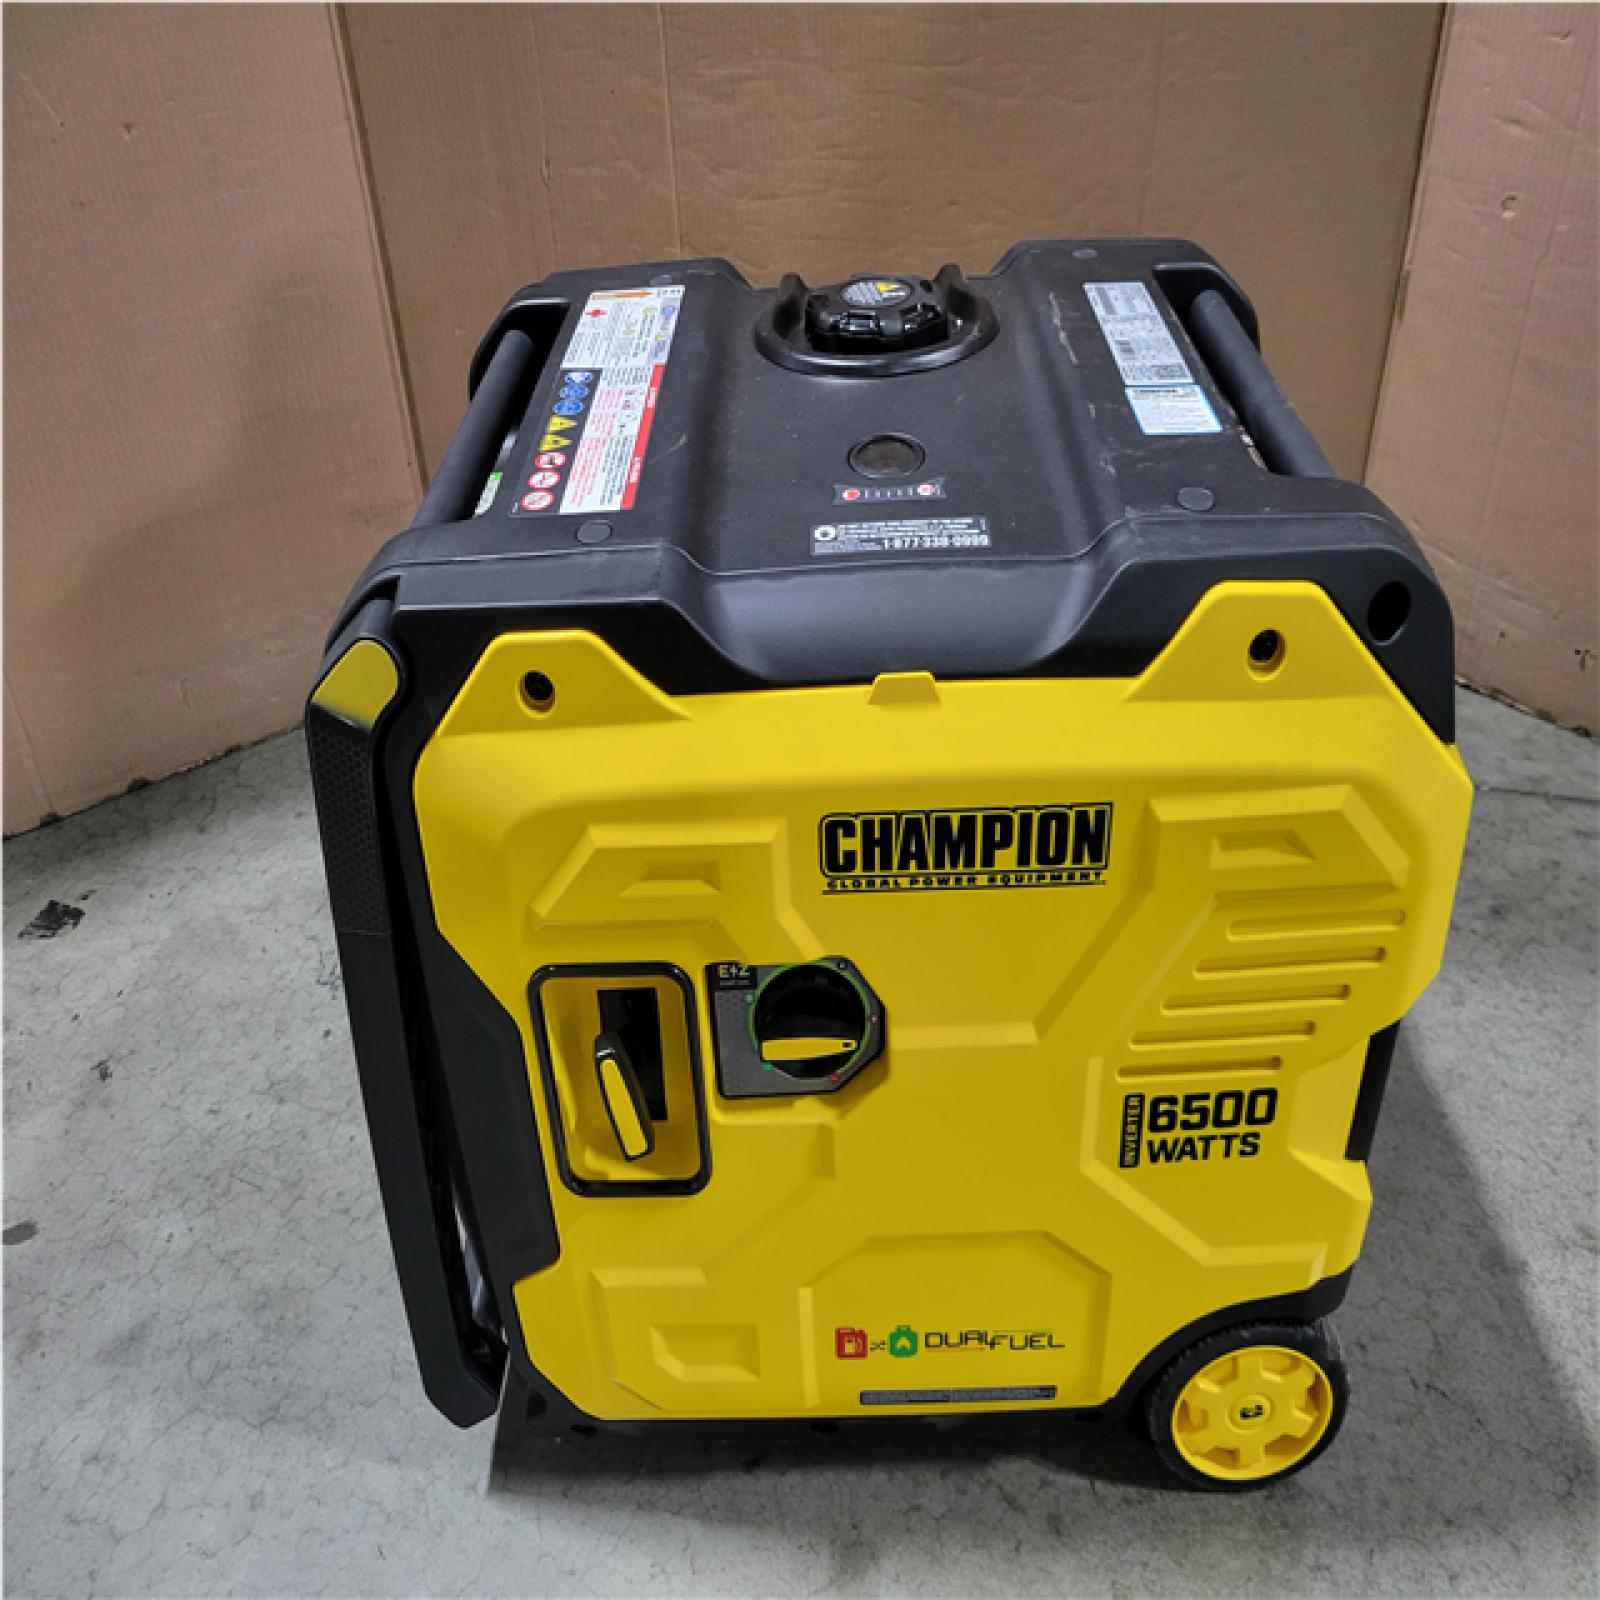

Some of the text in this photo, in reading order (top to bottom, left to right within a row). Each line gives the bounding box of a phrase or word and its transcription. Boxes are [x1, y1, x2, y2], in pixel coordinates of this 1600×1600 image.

[823, 807, 1108, 873] CHAMPION
[827, 869, 1103, 889] GLOBAL POWER EQUIPMENT
[1123, 1095, 1142, 1166] INVERTER
[1147, 1087, 1279, 1133] 6500
[1147, 1132, 1261, 1164] WATTS
